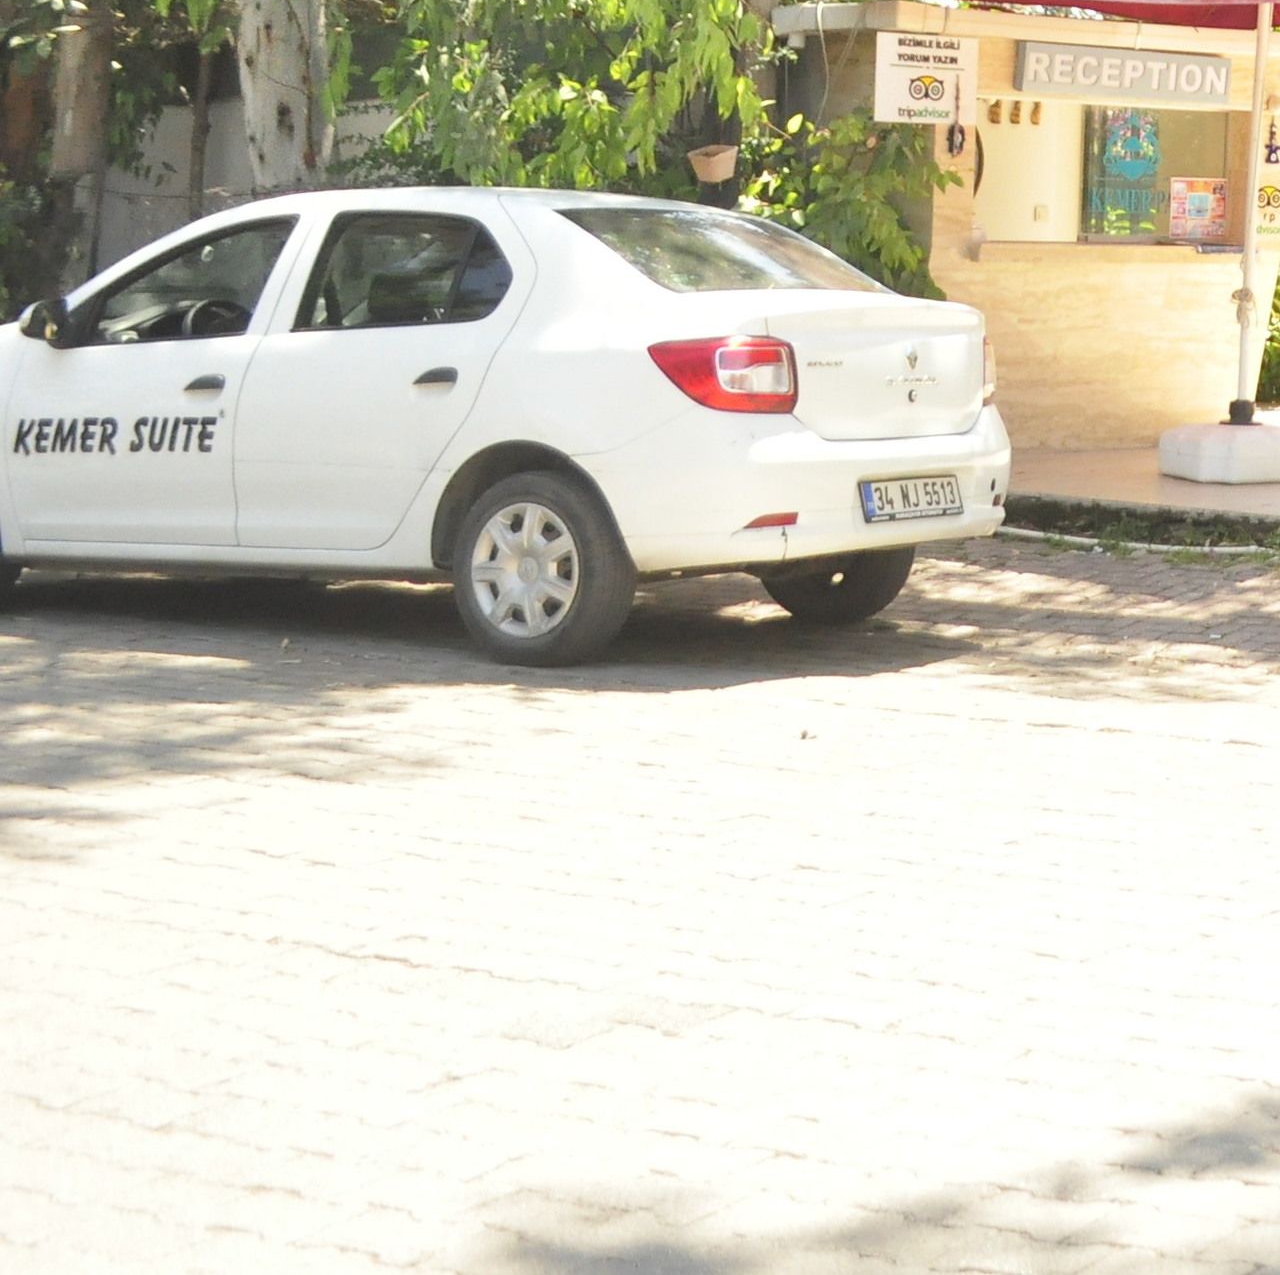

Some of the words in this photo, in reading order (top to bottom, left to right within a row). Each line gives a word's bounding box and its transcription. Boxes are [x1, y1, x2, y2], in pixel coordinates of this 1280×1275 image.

[898, 36, 933, 48] BİZİMLE
[897, 53, 930, 63] YORUM
[932, 55, 958, 64] YAZIN
[1026, 52, 1229, 96] RECEPTION
[898, 106, 950, 119] tripadvisor
[13, 417, 118, 455] KEMER
[130, 416, 218, 453] SUITE
[874, 486, 894, 511] 34
[900, 483, 920, 509] NJ
[923, 481, 956, 507] 5513
